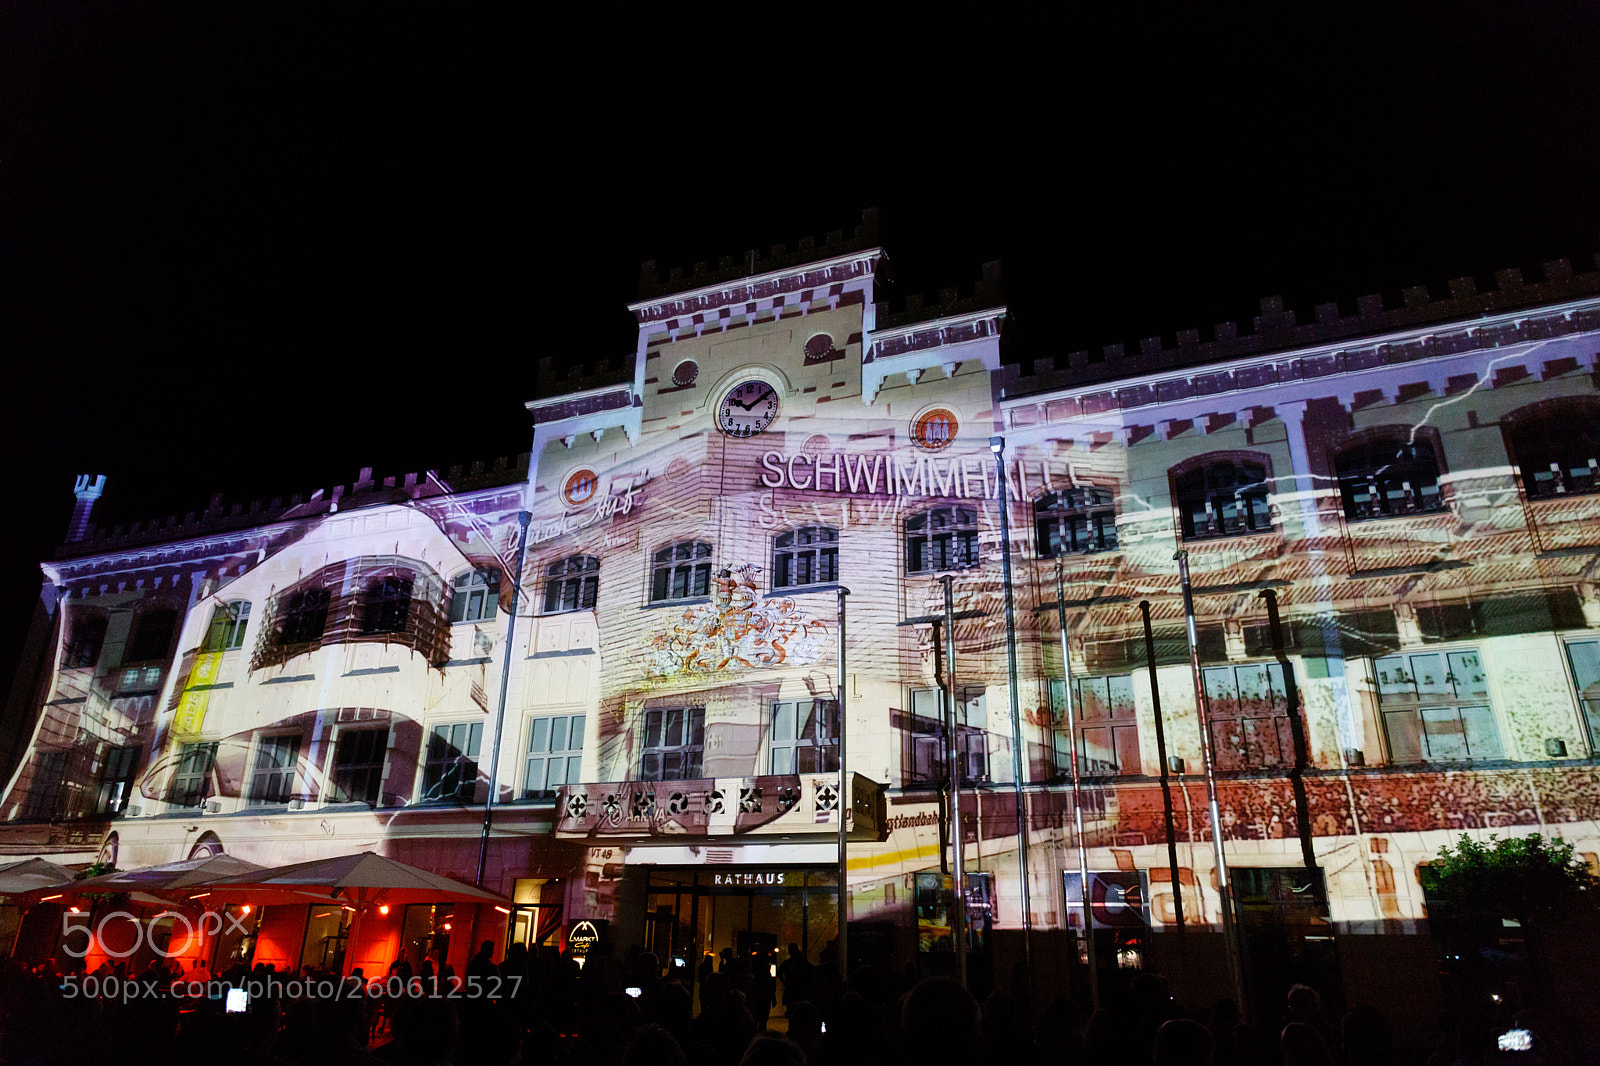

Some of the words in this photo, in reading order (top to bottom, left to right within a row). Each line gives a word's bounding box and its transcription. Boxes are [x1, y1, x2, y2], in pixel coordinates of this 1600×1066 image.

[767, 400, 773, 410] 3
[725, 408, 731, 417] 9
[763, 411, 769, 420] 4
[728, 417, 734, 426] 8
[755, 420, 761, 428] 5
[745, 424, 751, 433] 6
[714, 873, 785, 885] RATHAUS
